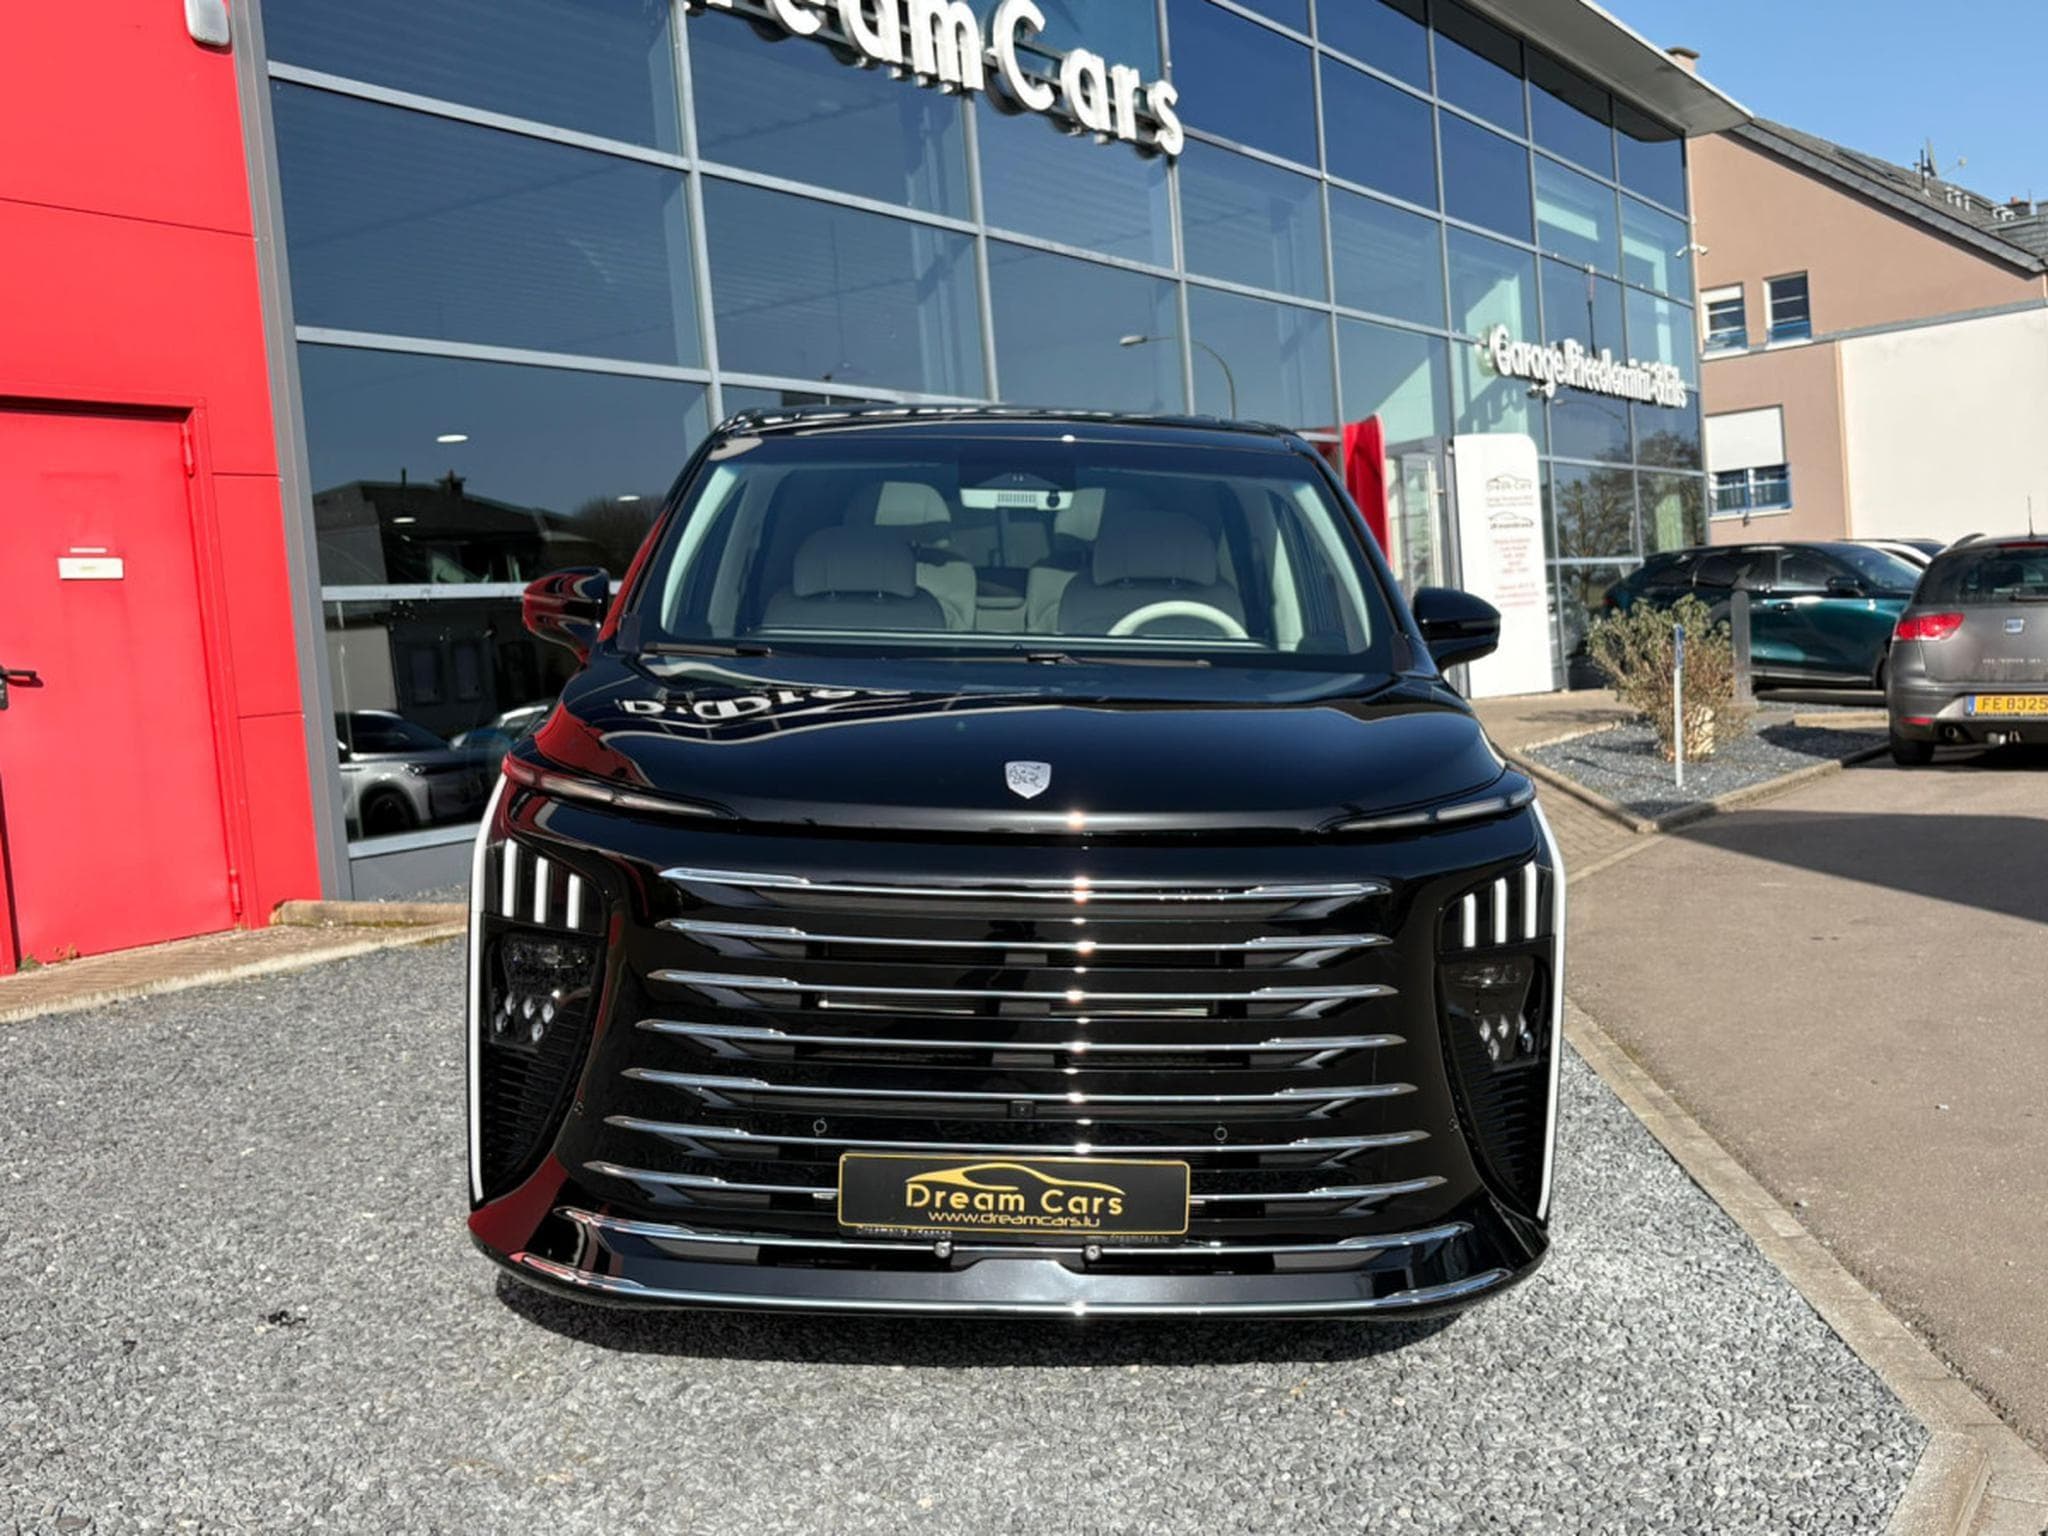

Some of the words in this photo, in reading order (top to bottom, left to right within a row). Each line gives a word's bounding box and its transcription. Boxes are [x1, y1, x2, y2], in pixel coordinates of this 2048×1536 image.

[990, 0, 1185, 156] Cars
[1489, 323, 1563, 398] Garage
[1982, 697, 2002, 710] FE
[2006, 697, 2048, 711] 8325
[906, 1183, 1025, 1212] Dream
[1040, 1189, 1123, 1215] Cars
[927, 1211, 1100, 1228] www.dreamcars.lu
